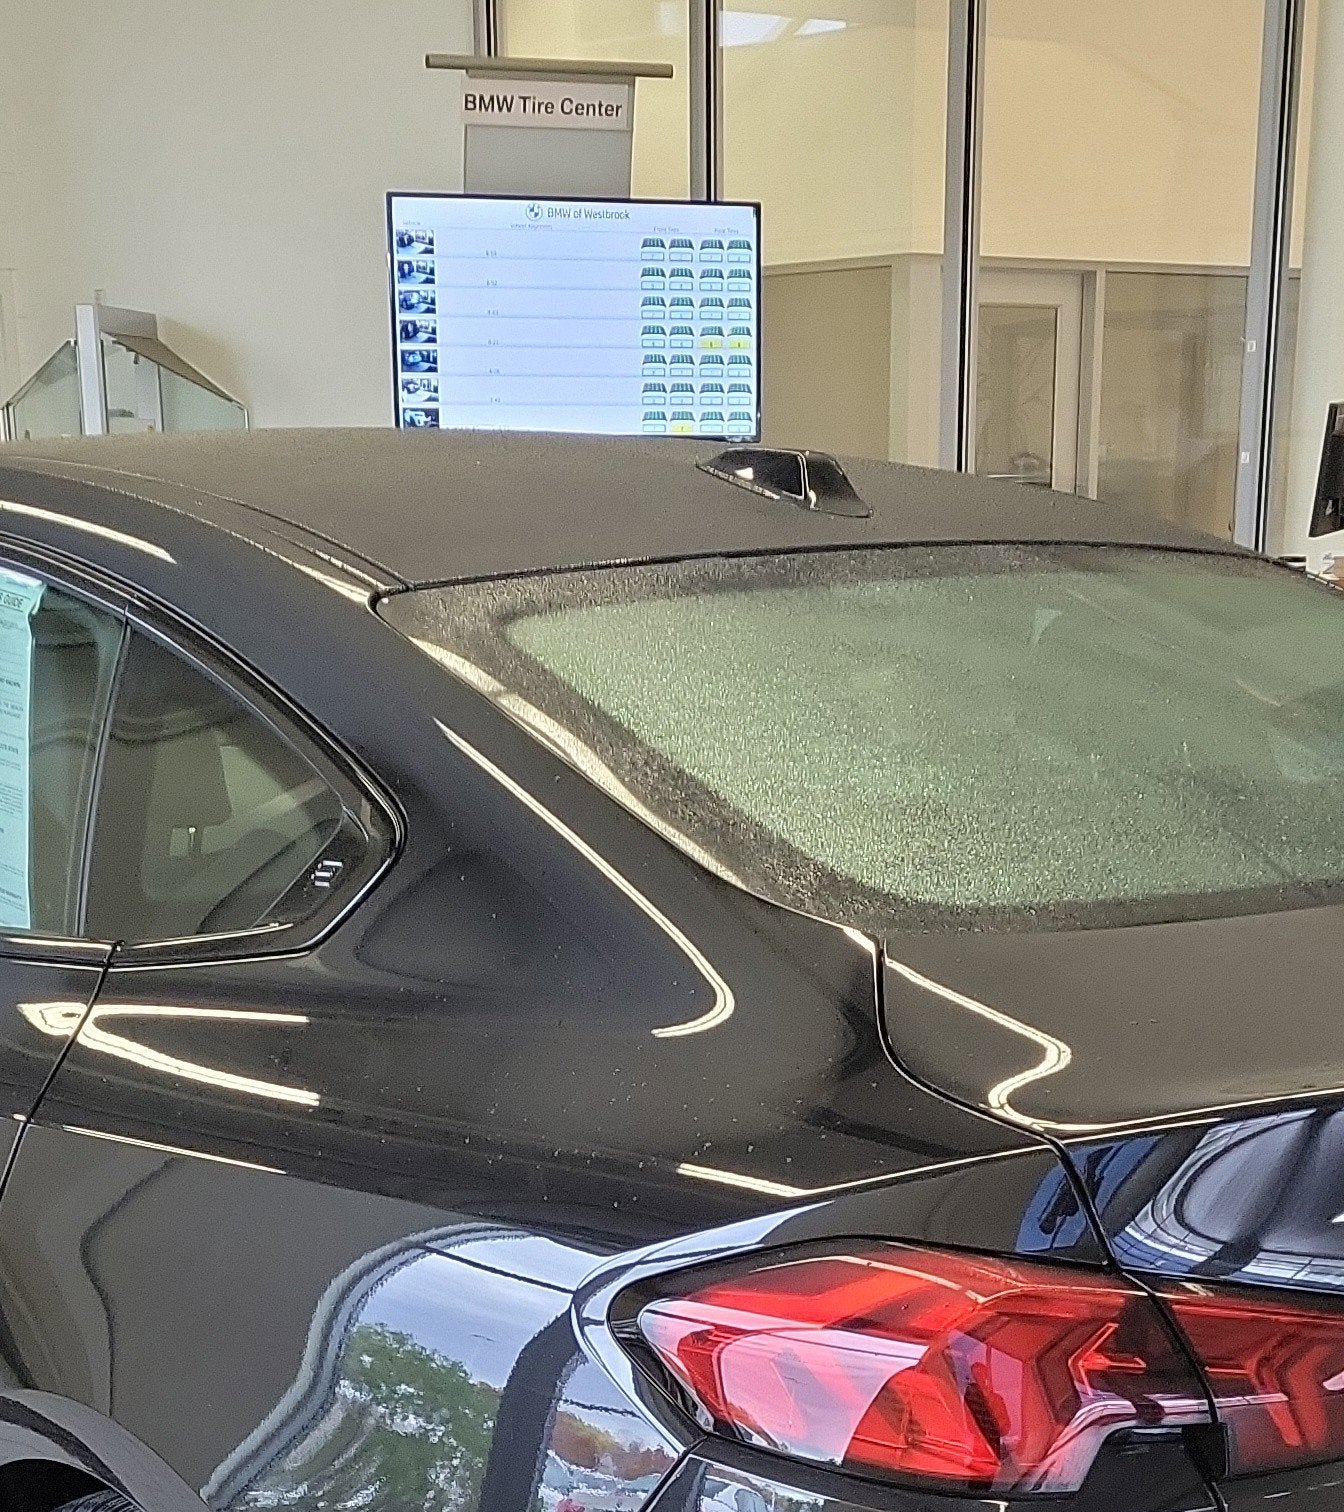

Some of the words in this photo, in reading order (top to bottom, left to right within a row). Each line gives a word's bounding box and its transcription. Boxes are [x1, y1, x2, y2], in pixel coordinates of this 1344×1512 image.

[464, 93, 514, 113] BMW
[518, 95, 555, 115] Tire
[560, 97, 623, 117] Center
[547, 207, 571, 219] BMW
[573, 208, 582, 219] of
[584, 208, 631, 220] Westbrook
